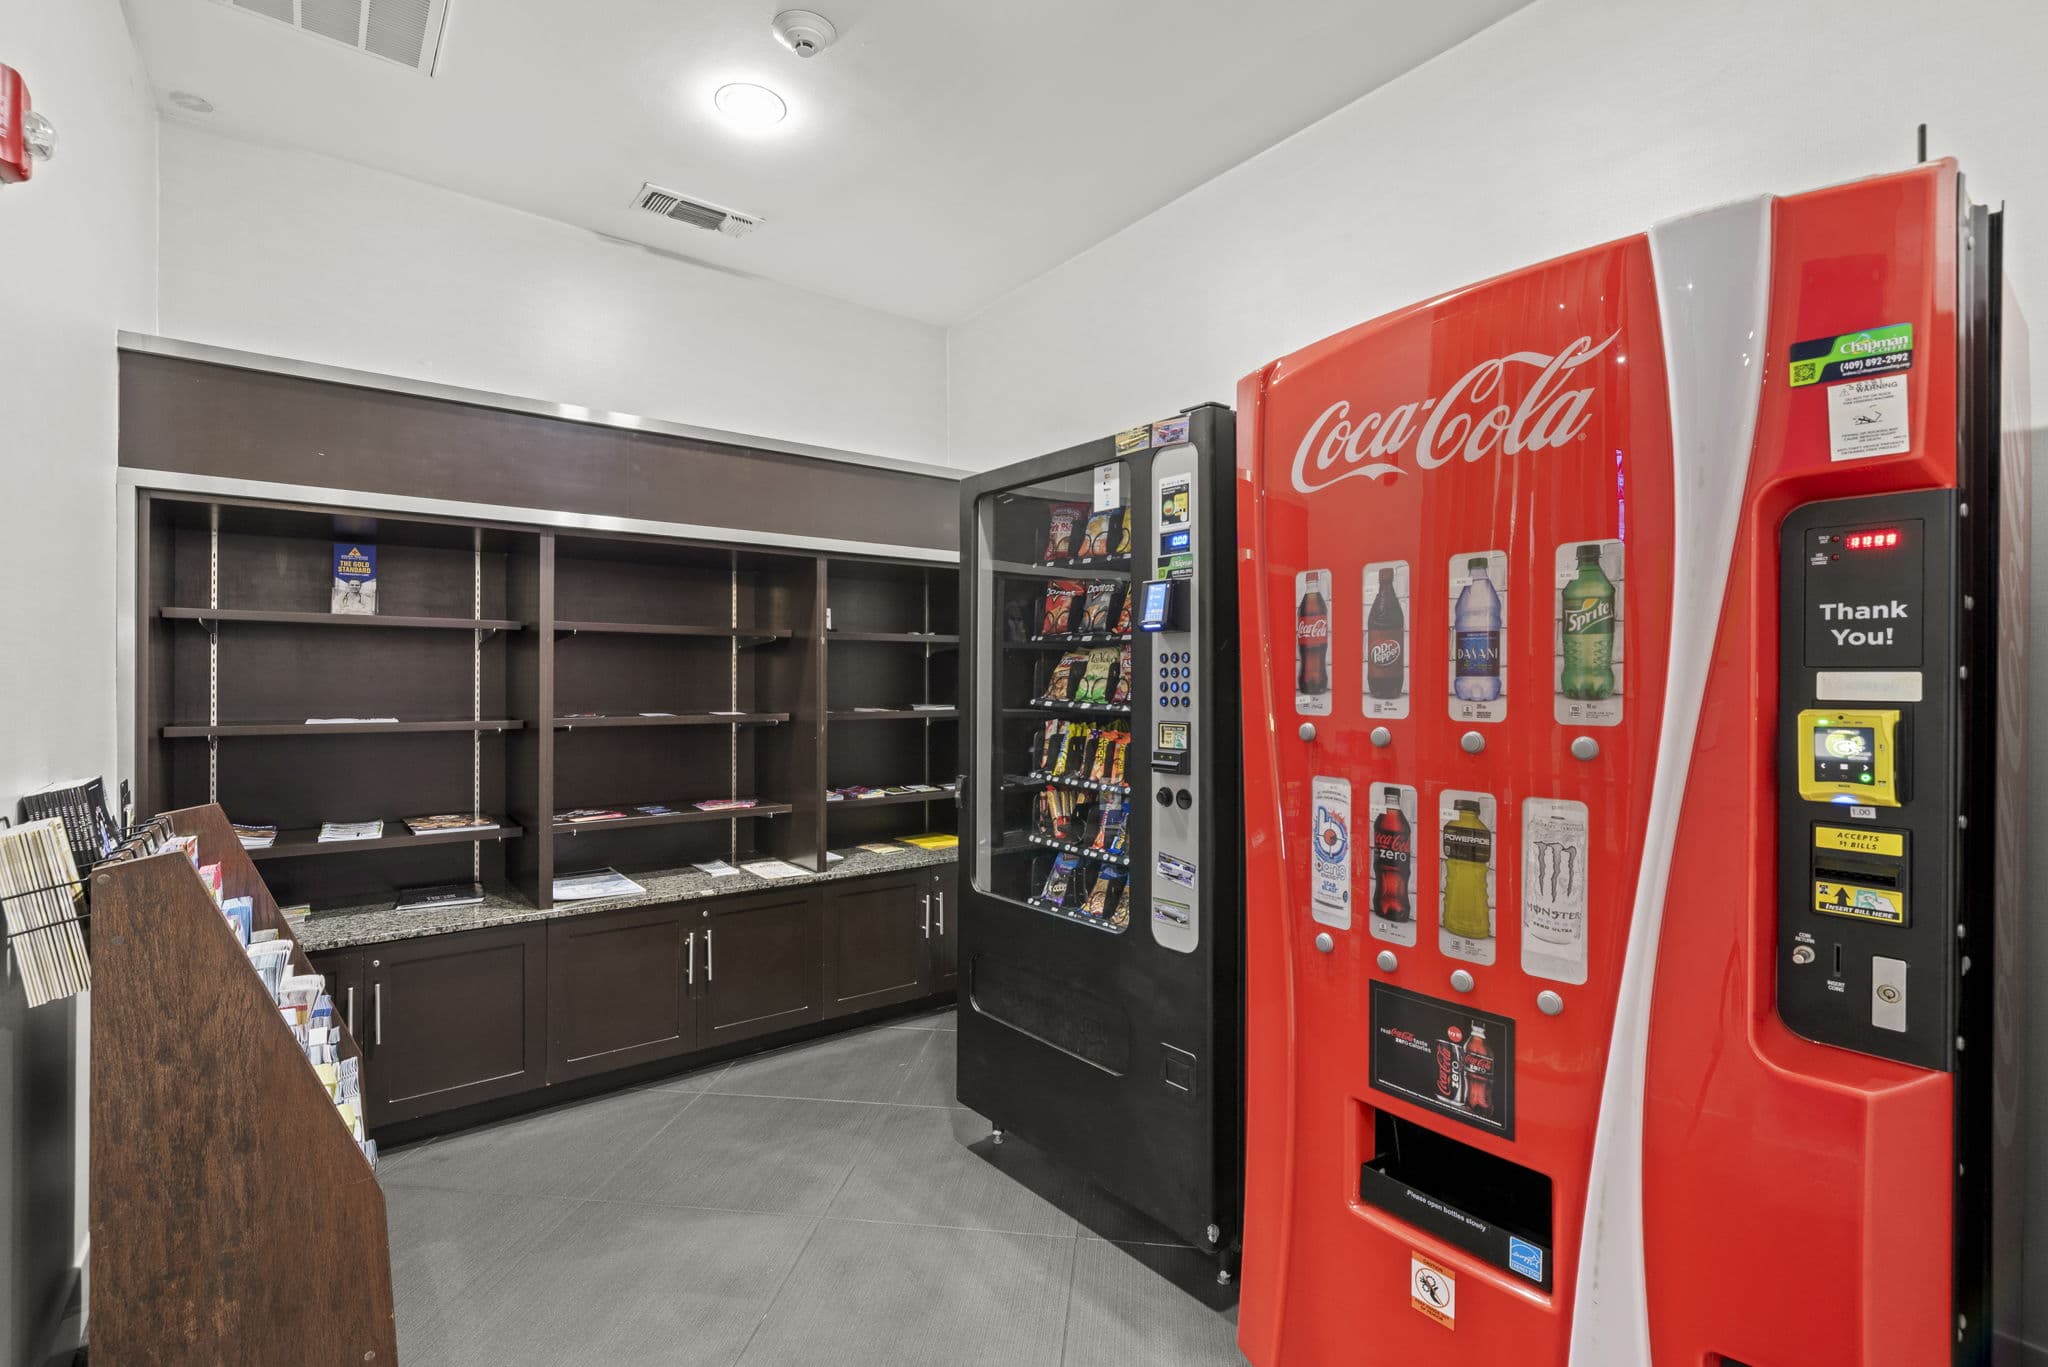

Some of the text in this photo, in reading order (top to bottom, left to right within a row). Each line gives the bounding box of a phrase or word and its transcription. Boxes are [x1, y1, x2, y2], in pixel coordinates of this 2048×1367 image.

[1840, 335, 1909, 354] Chapman
[1840, 360, 1863, 372] (409)
[1865, 353, 1909, 367] 892-2992
[1291, 327, 1622, 494] Coca-Cola
[338, 566, 371, 574] STANDARD
[1087, 583, 1115, 594] Doritos
[1568, 600, 1610, 632] Sprite
[1819, 600, 1908, 620] Thank
[1830, 627, 1894, 646] You!
[1380, 642, 1393, 653] Dr
[1457, 648, 1498, 660] DASANI
[1444, 833, 1491, 845] POWERADE
[1837, 832, 1880, 842] ACCEPTS
[1851, 842, 1878, 851] BILLS
[1379, 848, 1407, 862] zero
[1825, 903, 1894, 919] INSERT BILL HERE
[1395, 1037, 1431, 1054] zero calories
[1451, 1061, 1459, 1088] zero
[1469, 1064, 1486, 1074] zero
[1406, 1189, 1486, 1232] Please open bottles slowly
